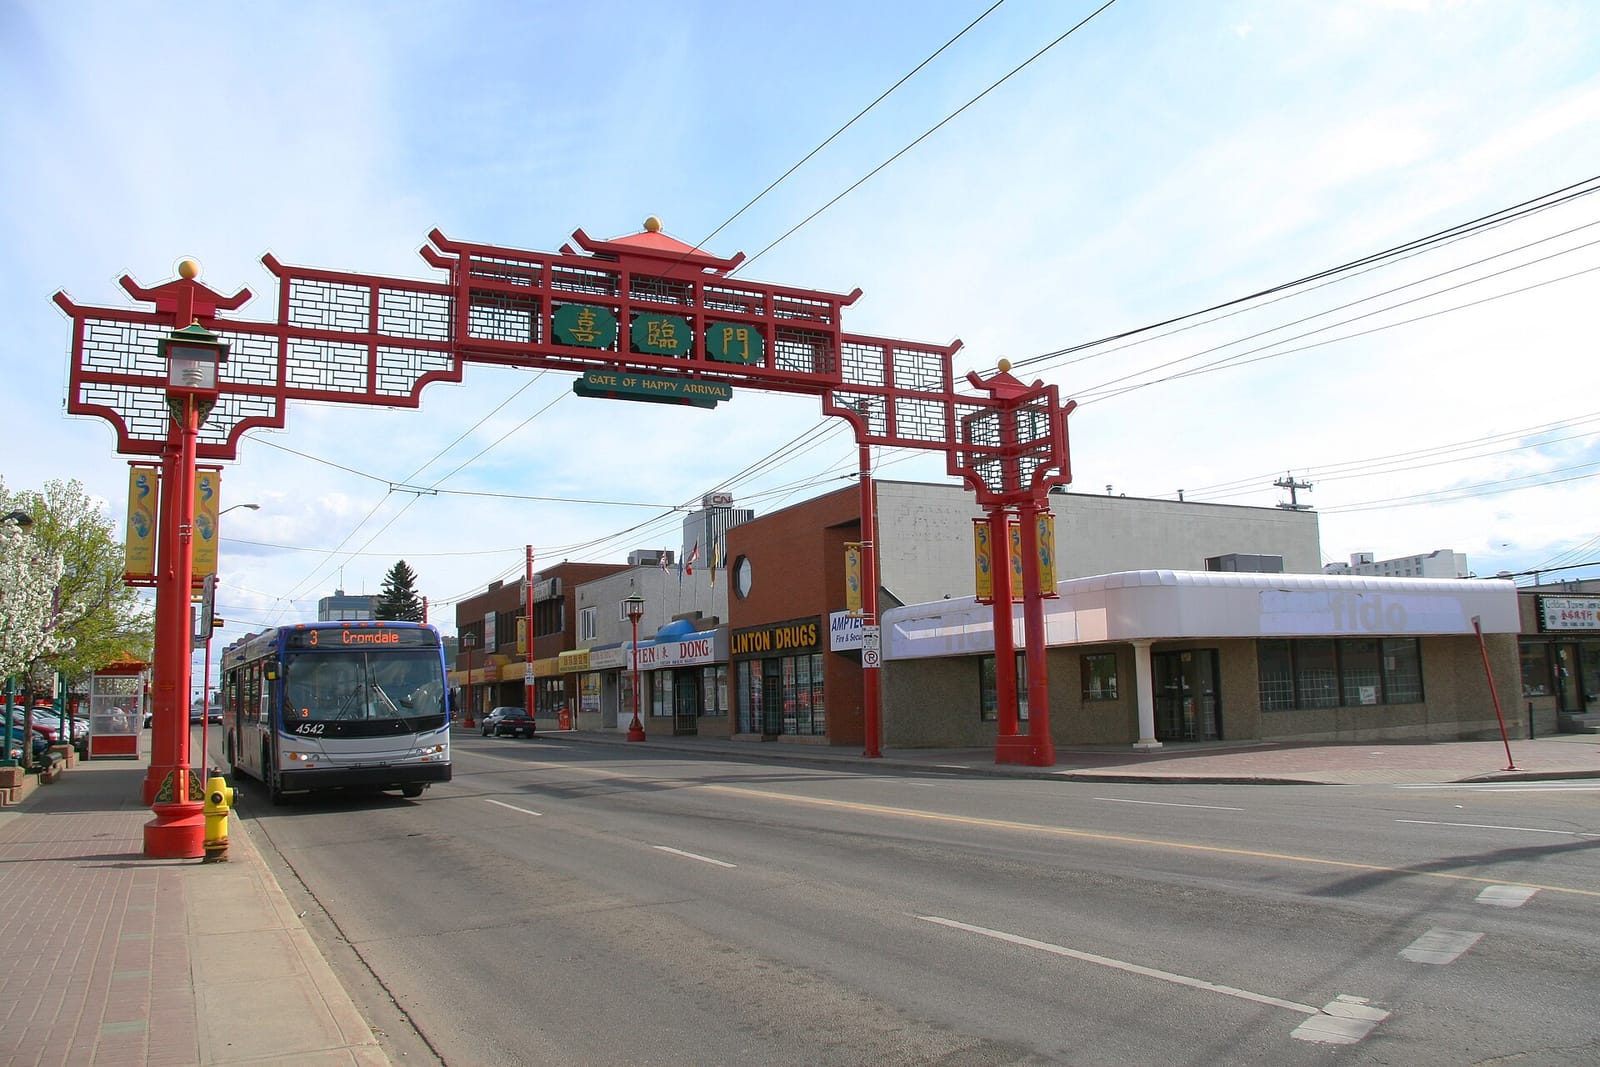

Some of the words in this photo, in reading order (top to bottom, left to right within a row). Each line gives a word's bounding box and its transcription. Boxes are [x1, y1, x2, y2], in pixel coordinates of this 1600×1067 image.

[589, 375, 617, 386] GATE
[622, 378, 637, 388] OF
[642, 380, 678, 392] HAPPY
[683, 384, 728, 397] ARRIVAL
[1329, 592, 1407, 631] fido
[309, 629, 319, 646] 3
[342, 630, 399, 644] Cromdale
[731, 631, 770, 654] LINTON
[776, 624, 817, 649] DRUGS
[630, 646, 656, 664] IEN
[679, 639, 709, 659] DONG
[302, 708, 309, 717] 3
[295, 723, 325, 735] 4542
